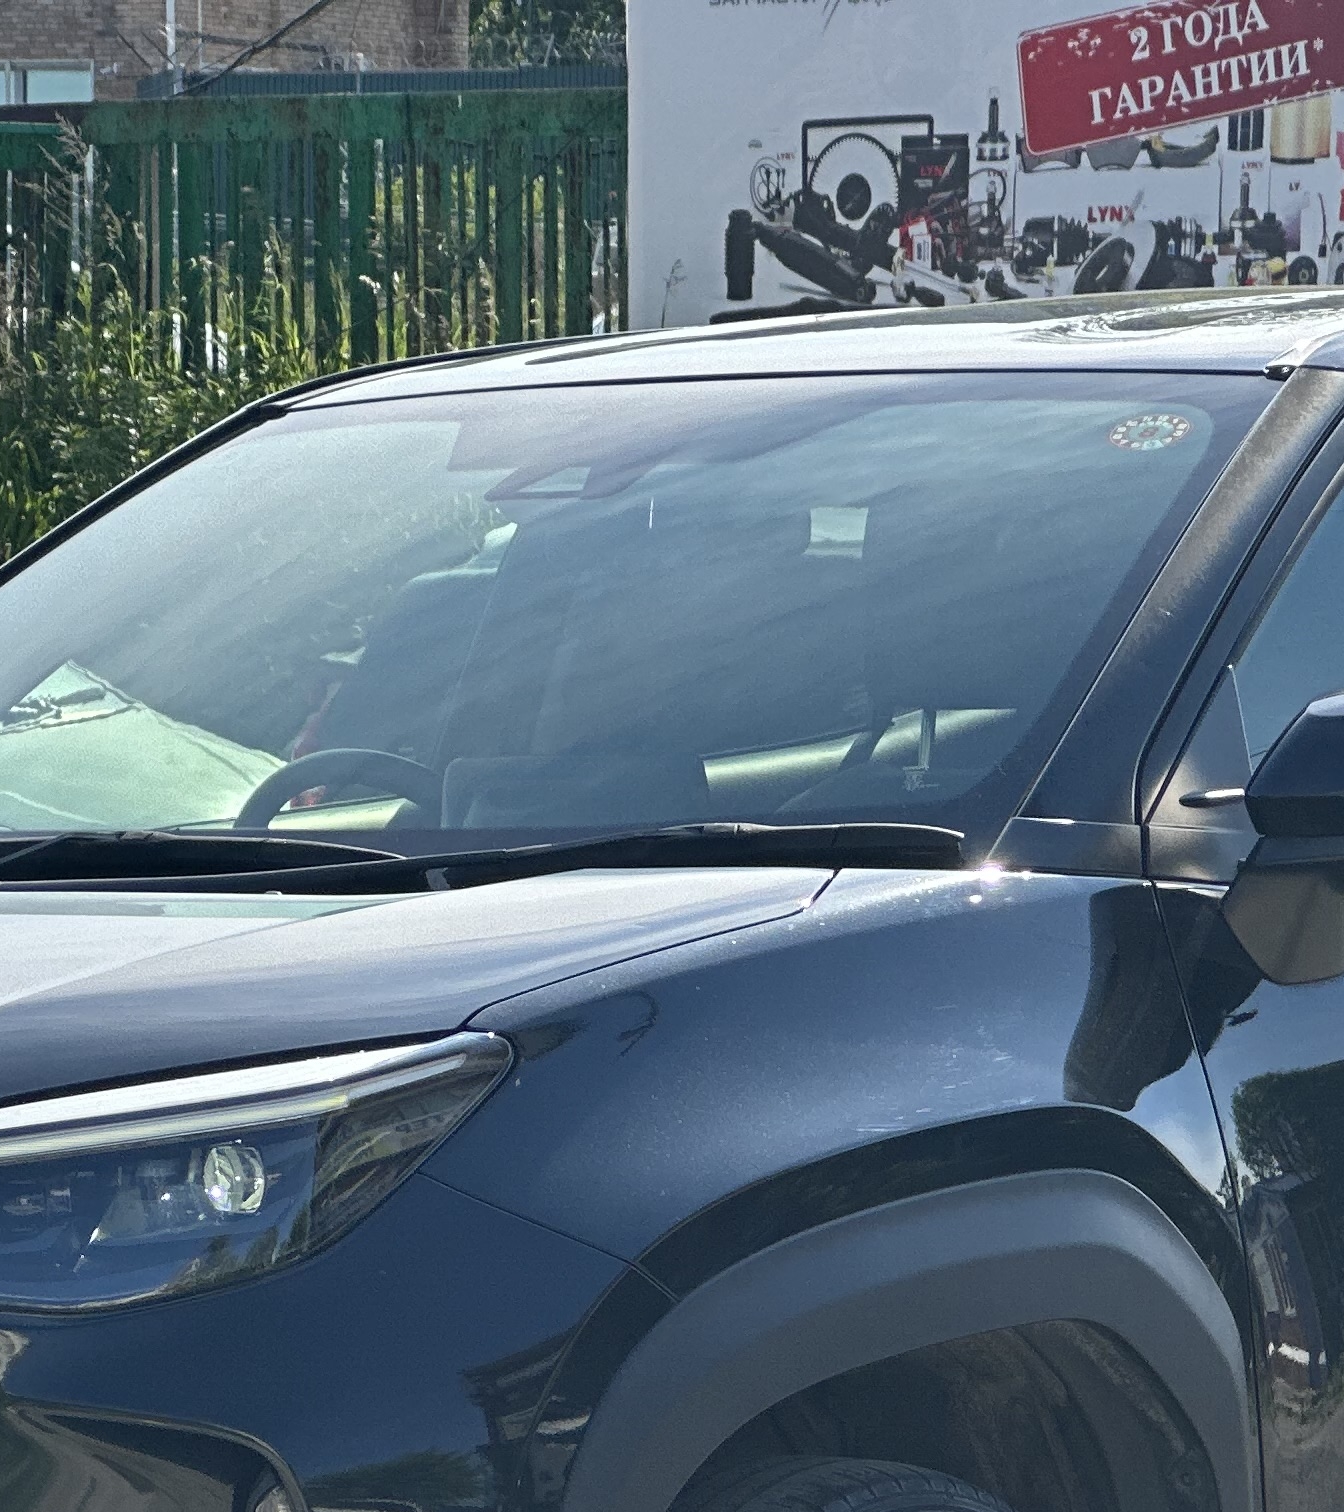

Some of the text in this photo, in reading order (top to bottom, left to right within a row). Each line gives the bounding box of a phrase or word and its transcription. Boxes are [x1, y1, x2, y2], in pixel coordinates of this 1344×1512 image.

[1130, 0, 1270, 62] 2 ГОДА
[919, 164, 952, 177] LYN
